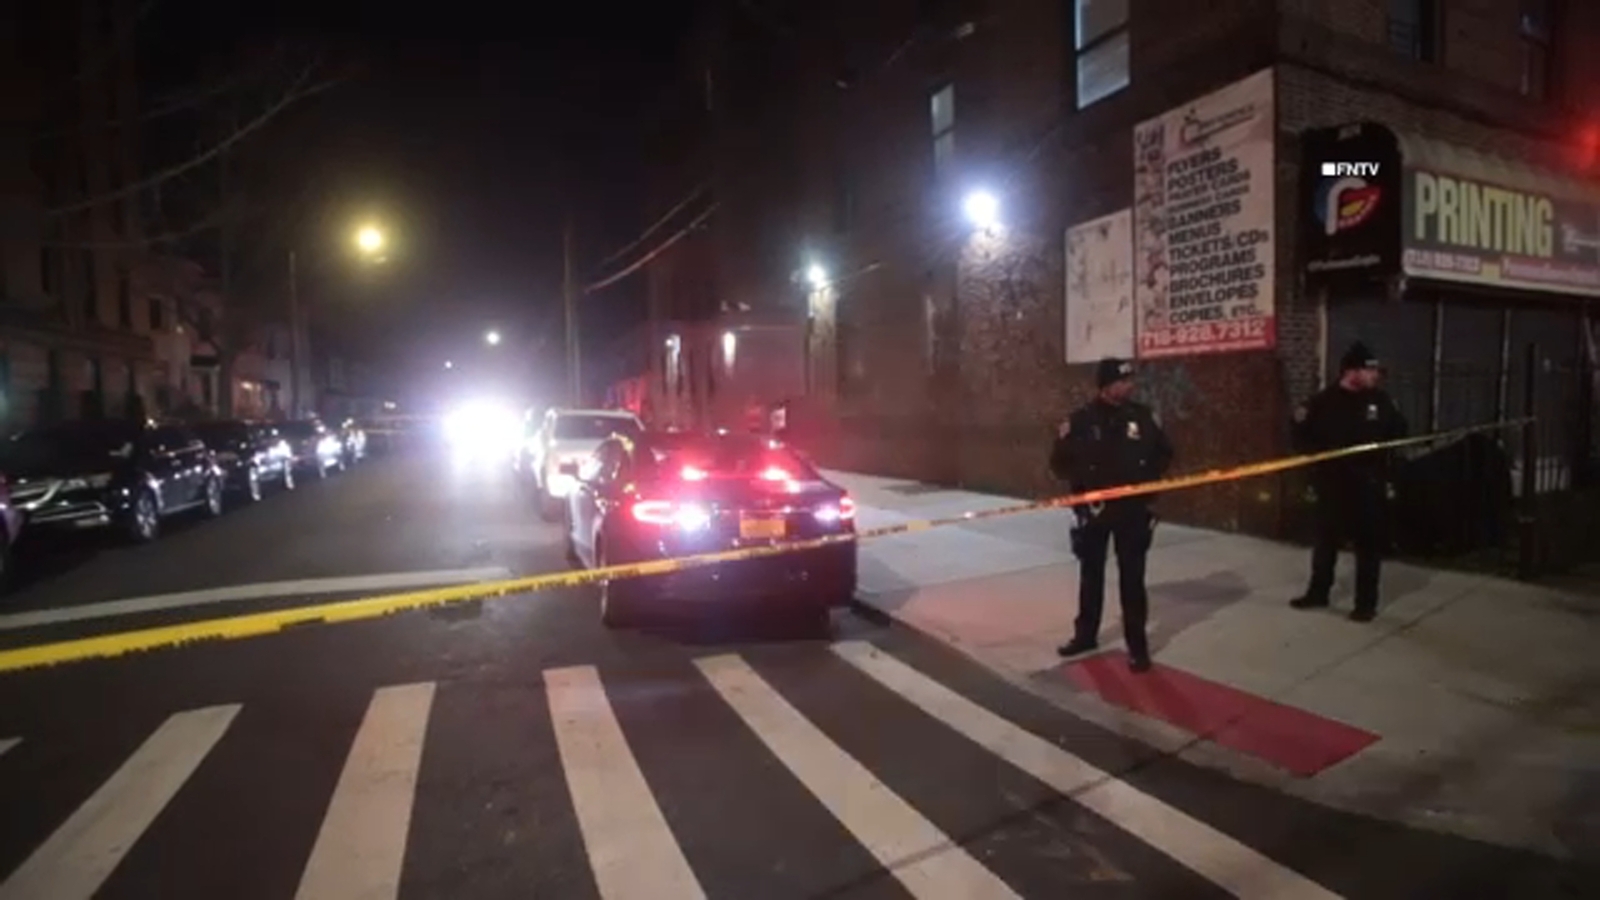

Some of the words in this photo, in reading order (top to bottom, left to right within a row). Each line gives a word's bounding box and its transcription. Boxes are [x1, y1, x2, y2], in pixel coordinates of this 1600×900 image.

[1167, 147, 1222, 174] FLYERS
[1167, 157, 1238, 190] POSTERS
[1167, 199, 1241, 229] BANNERS
[1415, 171, 1554, 258] PRINTING
[1168, 221, 1221, 245] MENUS
[1169, 249, 1256, 277] PROGRAMS
[1169, 263, 1265, 294] BROCHURES
[1169, 282, 1258, 310] ENVELOPES
